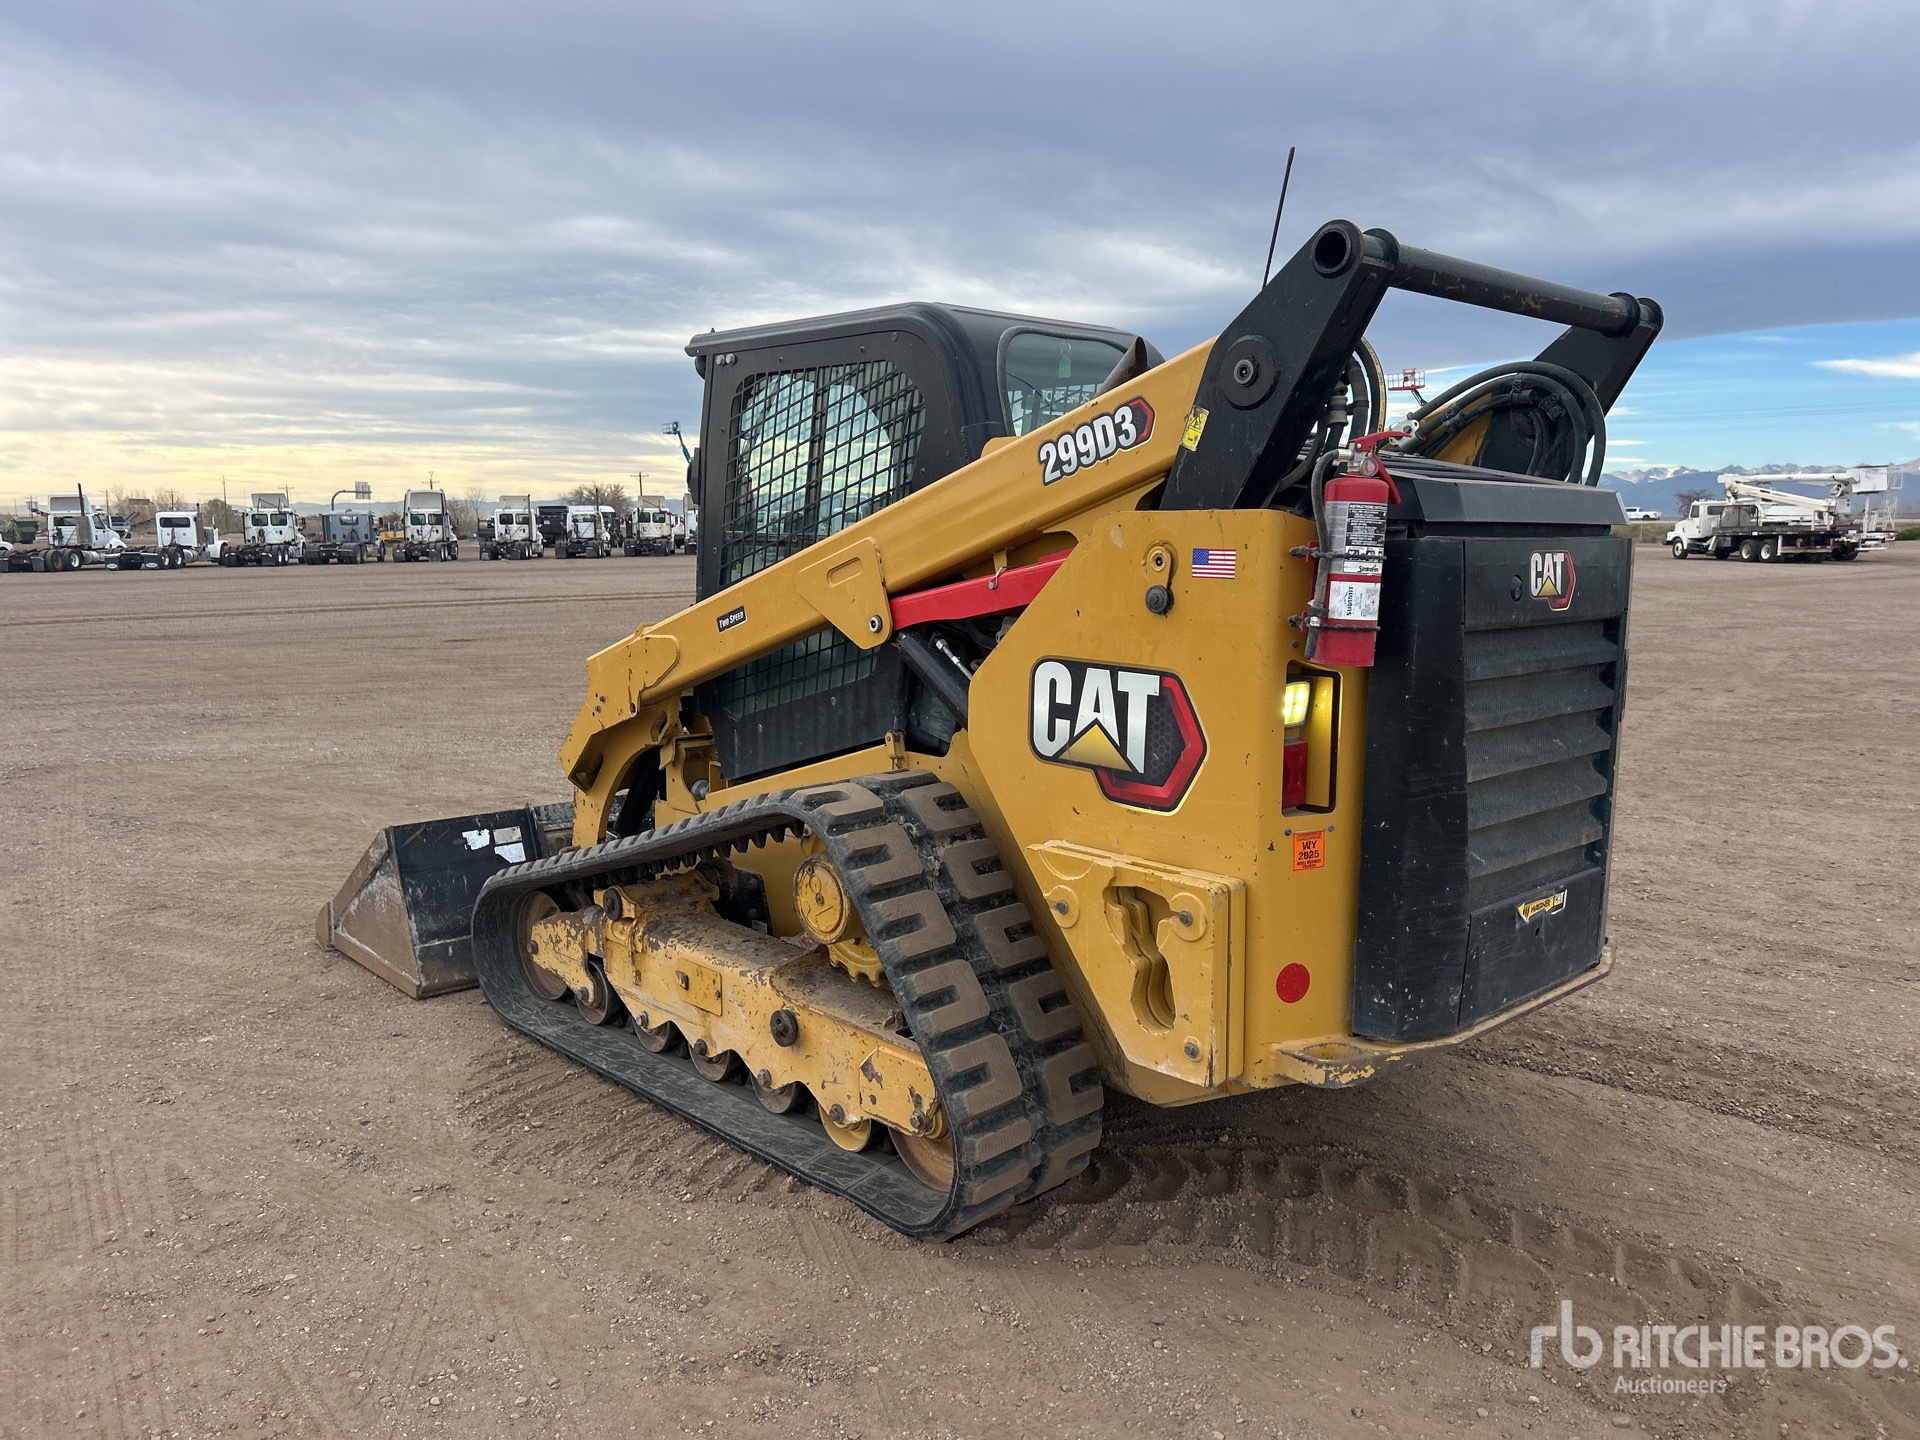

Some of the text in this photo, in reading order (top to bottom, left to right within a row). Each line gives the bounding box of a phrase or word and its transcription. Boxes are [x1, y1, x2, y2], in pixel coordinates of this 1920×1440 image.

[1039, 404, 1138, 484] 299D3
[1530, 552, 1565, 597] CAT
[1346, 585, 1354, 616] SUMMIT
[1033, 661, 1160, 774] CAT
[1298, 850, 1320, 861] 2025
[1302, 840, 1317, 850] WY
